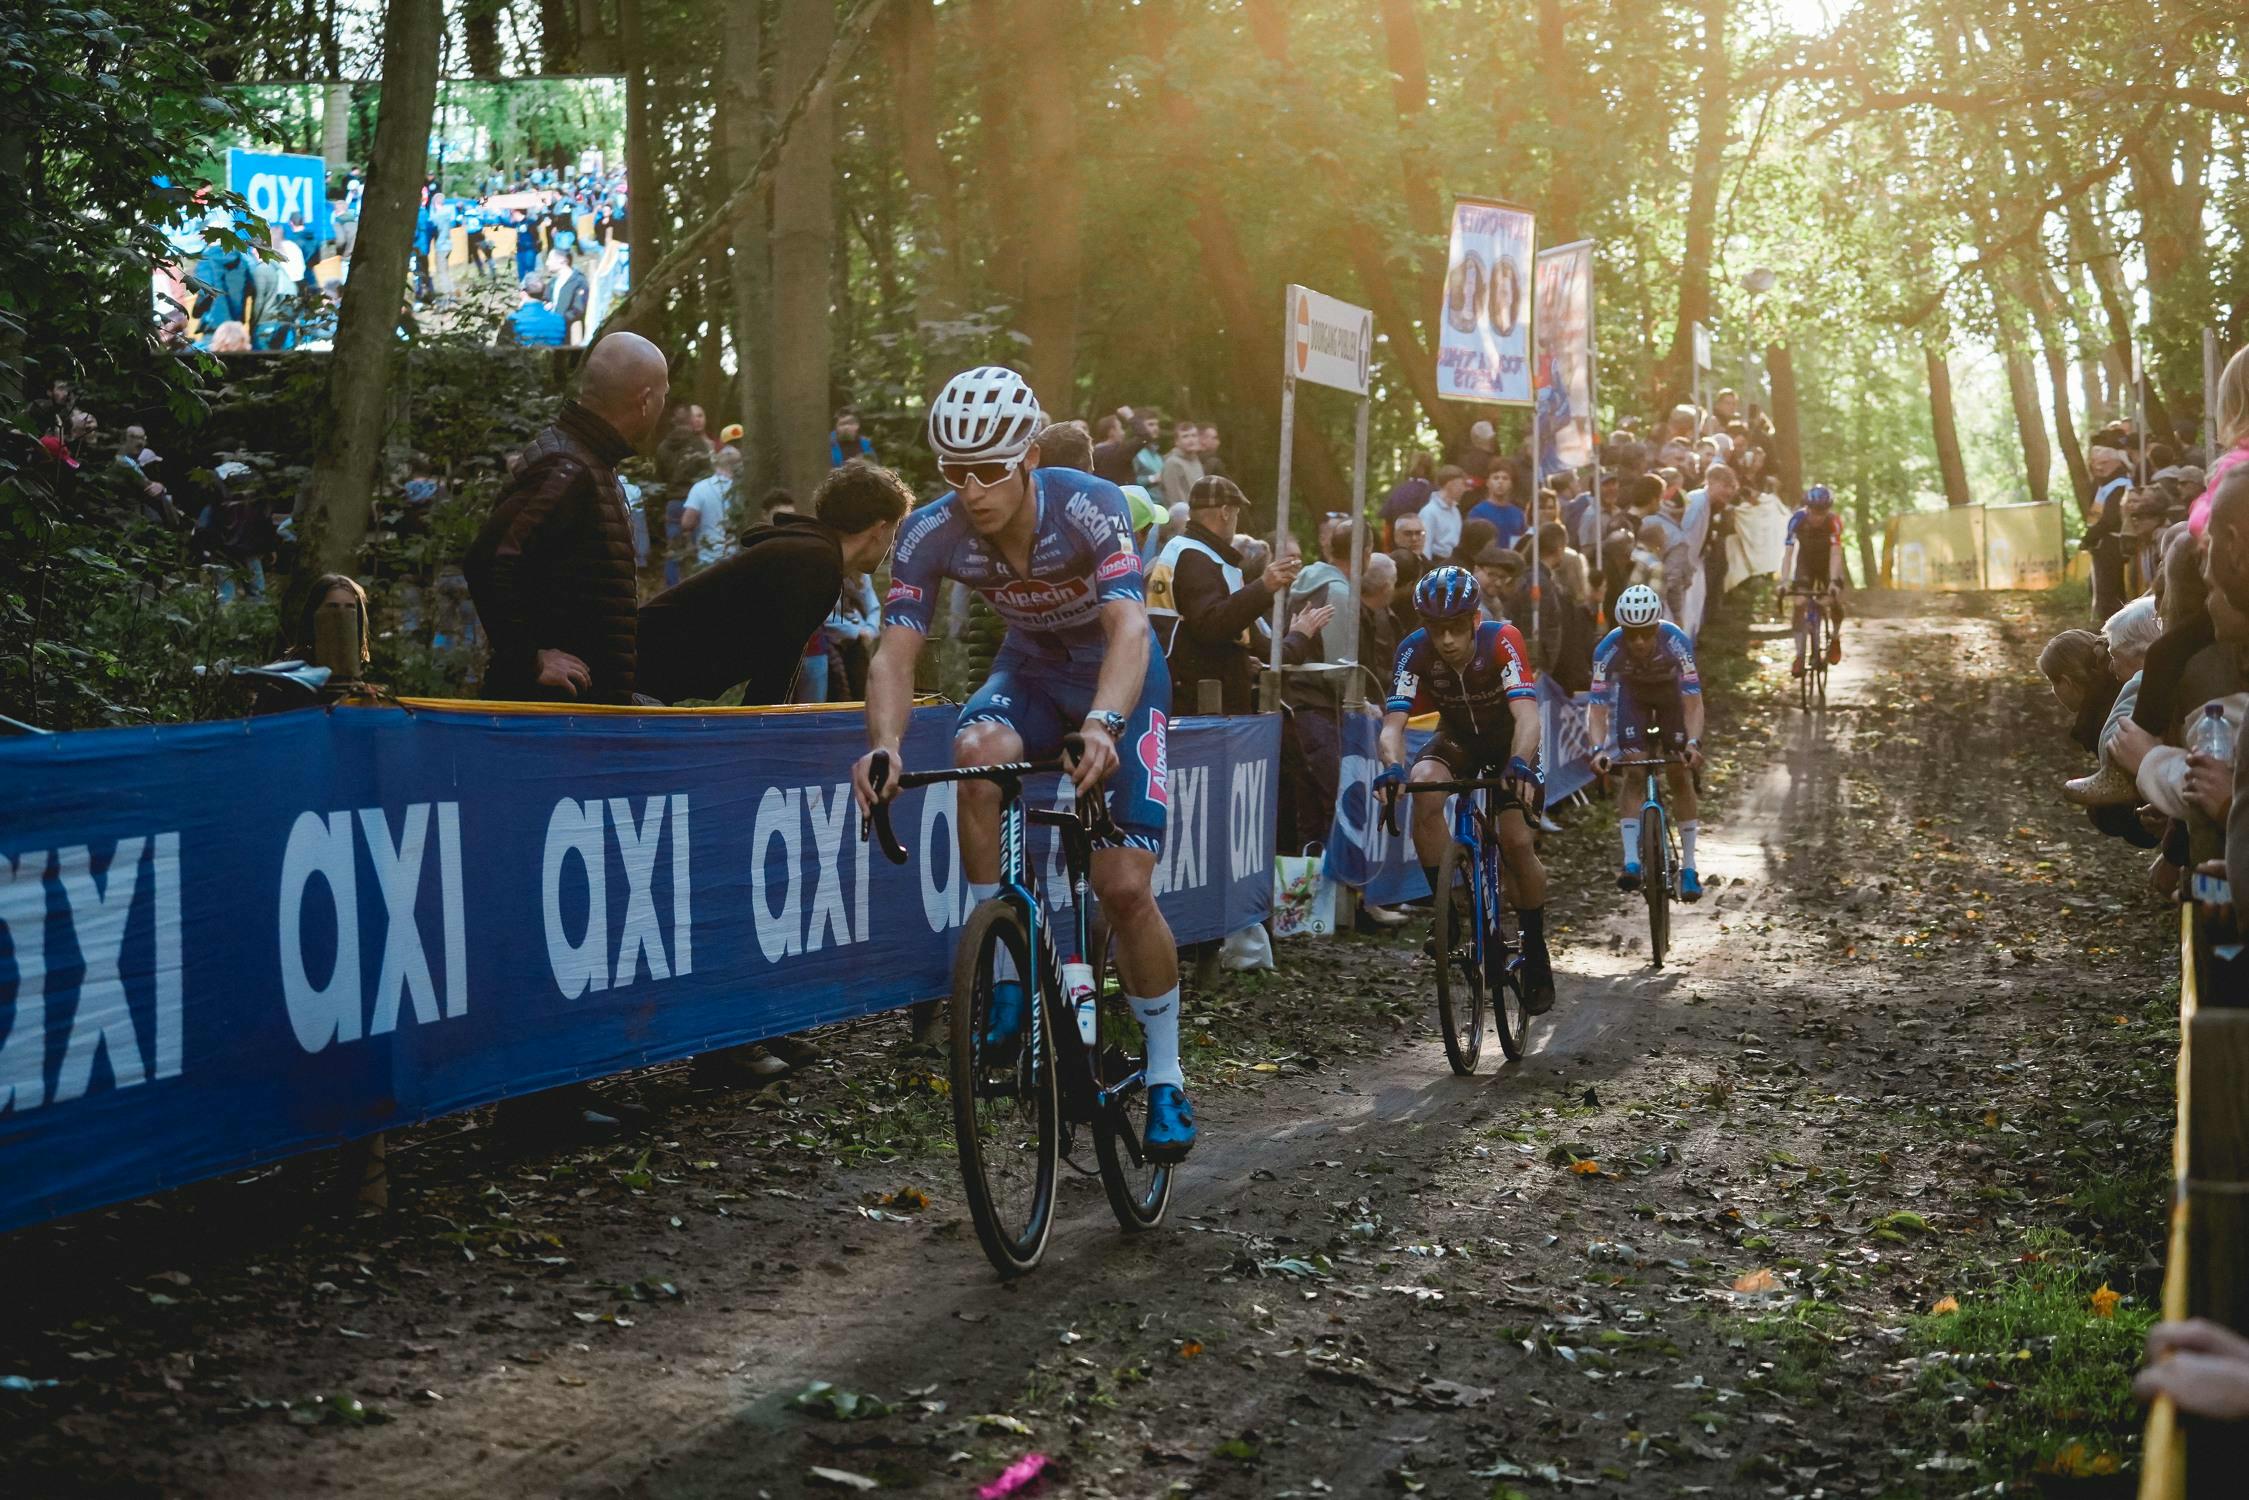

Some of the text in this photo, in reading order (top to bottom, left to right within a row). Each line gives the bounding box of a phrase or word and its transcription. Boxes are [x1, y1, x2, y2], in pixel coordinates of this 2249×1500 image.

[895, 505, 953, 564] deceuninck
[1064, 491, 1112, 547] Alpecin
[994, 584, 1076, 607] Alpecin
[1394, 647, 1414, 681] baloise
[1403, 672, 1414, 687] 3
[1501, 637, 1524, 672] TREK
[1152, 722, 1168, 794] Alpecin
[1231, 759, 1266, 883] axi
[542, 794, 693, 1001] axi
[279, 802, 468, 1054] axi
